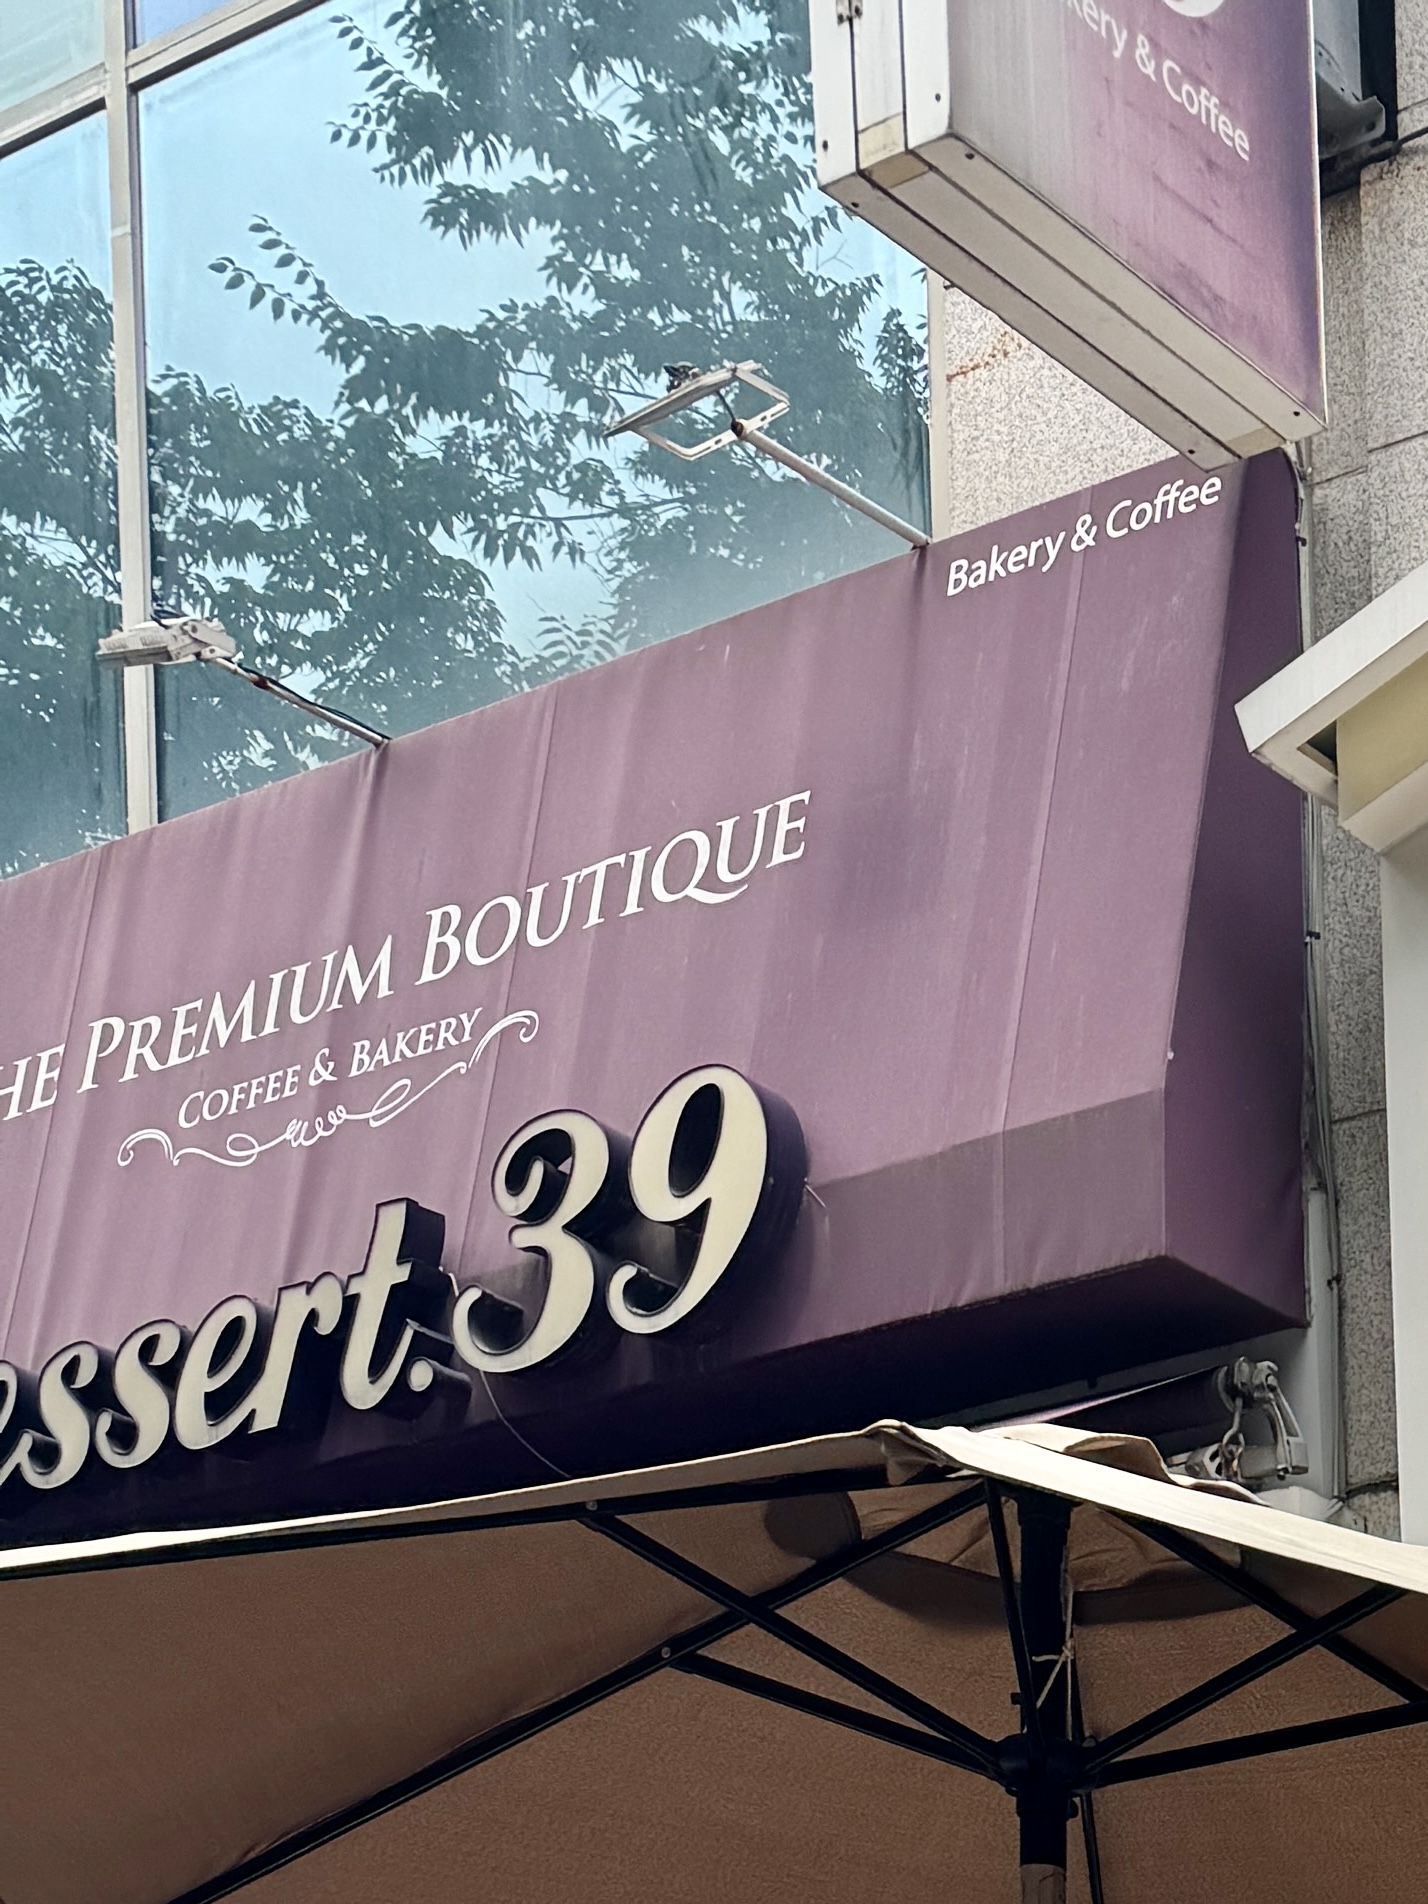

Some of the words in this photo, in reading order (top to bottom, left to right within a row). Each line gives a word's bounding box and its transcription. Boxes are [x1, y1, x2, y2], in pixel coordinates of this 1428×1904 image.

[1135, 34, 1156, 81] &
[1162, 60, 1250, 161] Coffee
[947, 531, 1066, 597] Bakery
[1070, 514, 1098, 552] &
[1106, 476, 1222, 539] Coffee
[77, 932, 397, 1094] PREMIUM
[418, 790, 813, 987] BOUTIQUE
[178, 1064, 300, 1129] COFFEE
[306, 1055, 338, 1087] &
[350, 1008, 480, 1075] BAKERY
